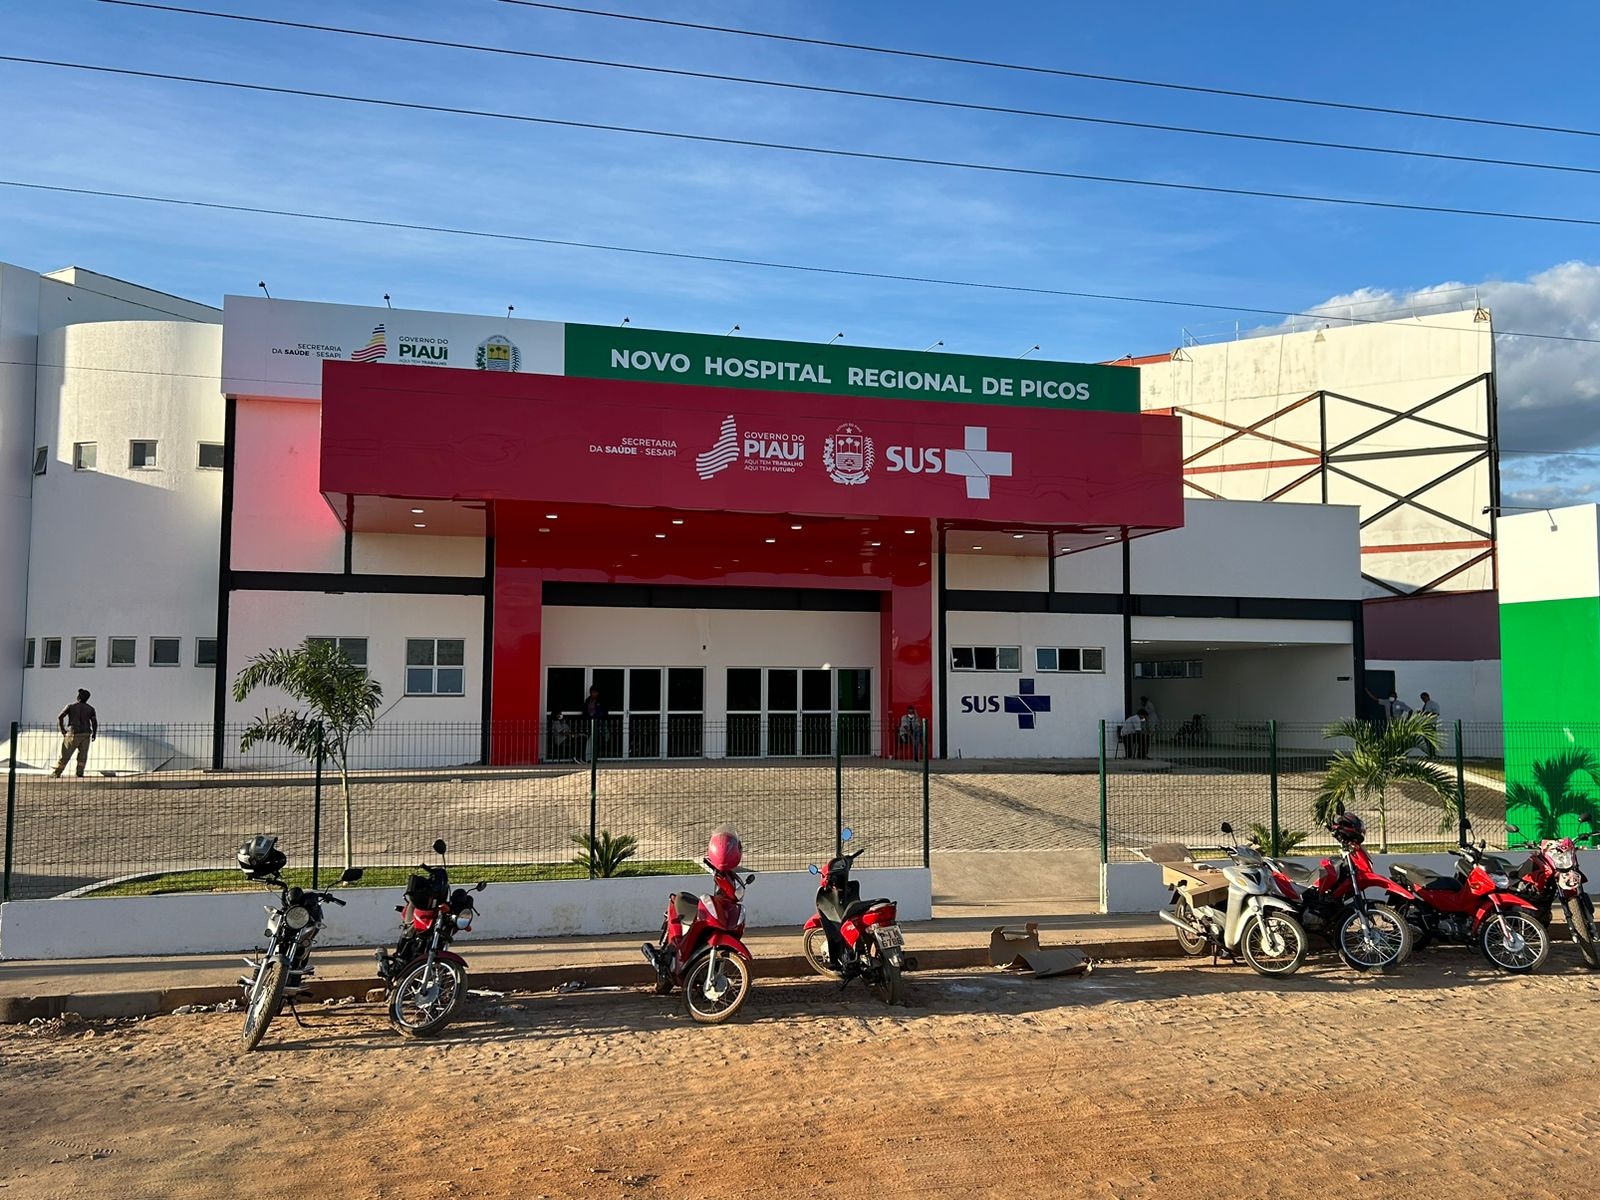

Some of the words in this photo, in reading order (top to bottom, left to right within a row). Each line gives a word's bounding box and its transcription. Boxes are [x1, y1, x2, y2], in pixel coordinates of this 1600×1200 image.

[398, 335, 435, 344] GOVERNO
[284, 348, 310, 356] SAÚDE
[297, 343, 342, 352] SECRETARIA
[399, 344, 448, 360] PIAUÍ
[611, 348, 691, 373] NOVO
[704, 356, 832, 384] HOSPITAL
[848, 367, 972, 394] REGIONAL
[982, 376, 1014, 396] DE
[1020, 379, 1090, 401] PICOS
[744, 431, 789, 441] GOVERNO
[621, 437, 678, 448] SECRETARIA
[589, 445, 604, 453] DA
[605, 445, 638, 455] SAÚDE
[645, 448, 677, 457] SESAPI
[744, 440, 804, 460] PIAUÍ
[886, 446, 942, 473] SUS
[961, 695, 1000, 713] SUS
